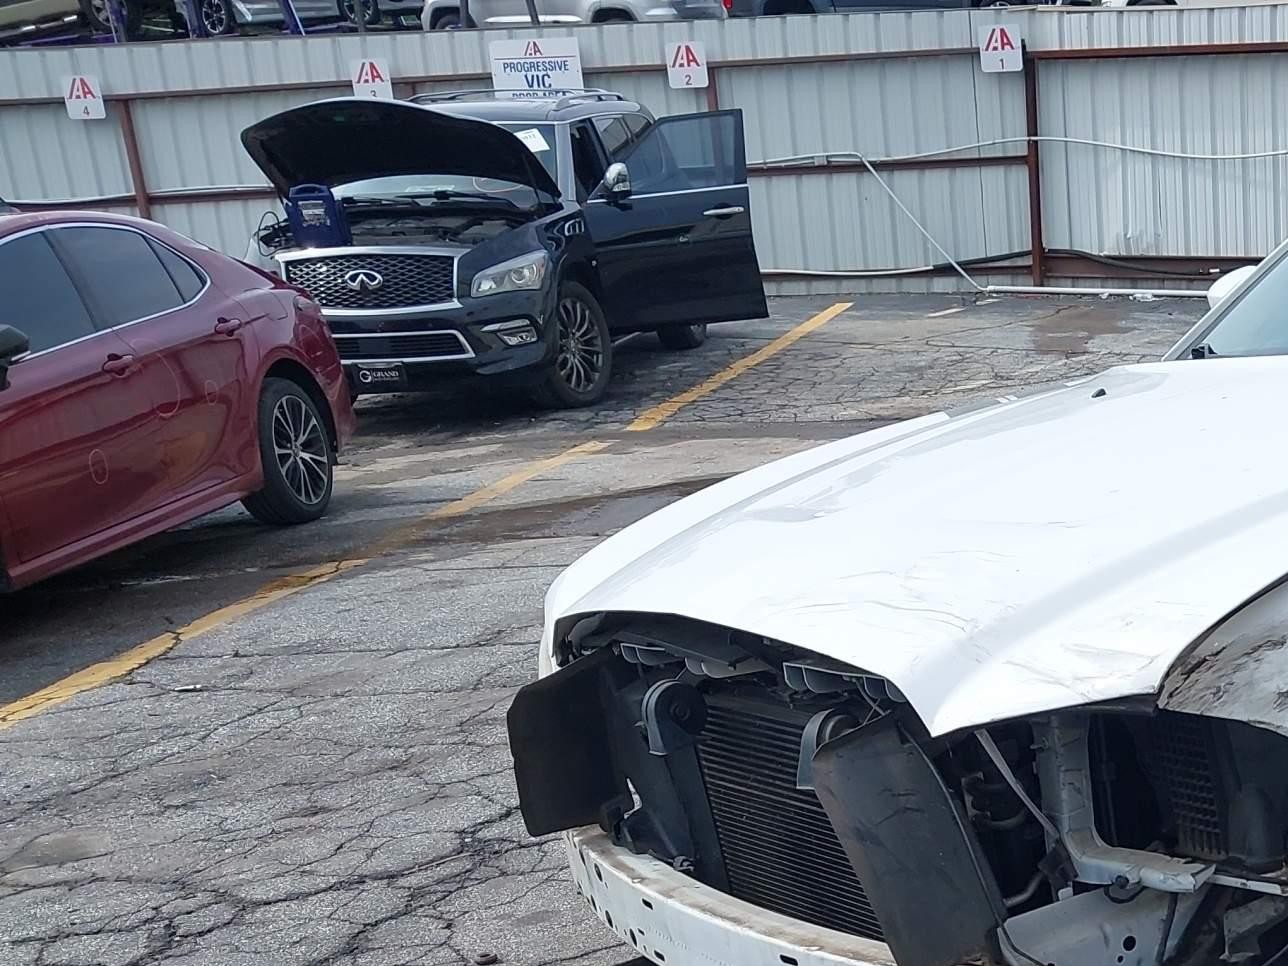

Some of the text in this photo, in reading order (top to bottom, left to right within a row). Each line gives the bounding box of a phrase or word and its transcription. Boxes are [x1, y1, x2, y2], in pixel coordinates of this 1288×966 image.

[503, 60, 569, 73] PROGRESSIVE
[524, 73, 551, 88] VIC
[685, 74, 692, 85] 2
[83, 105, 90, 116] 4
